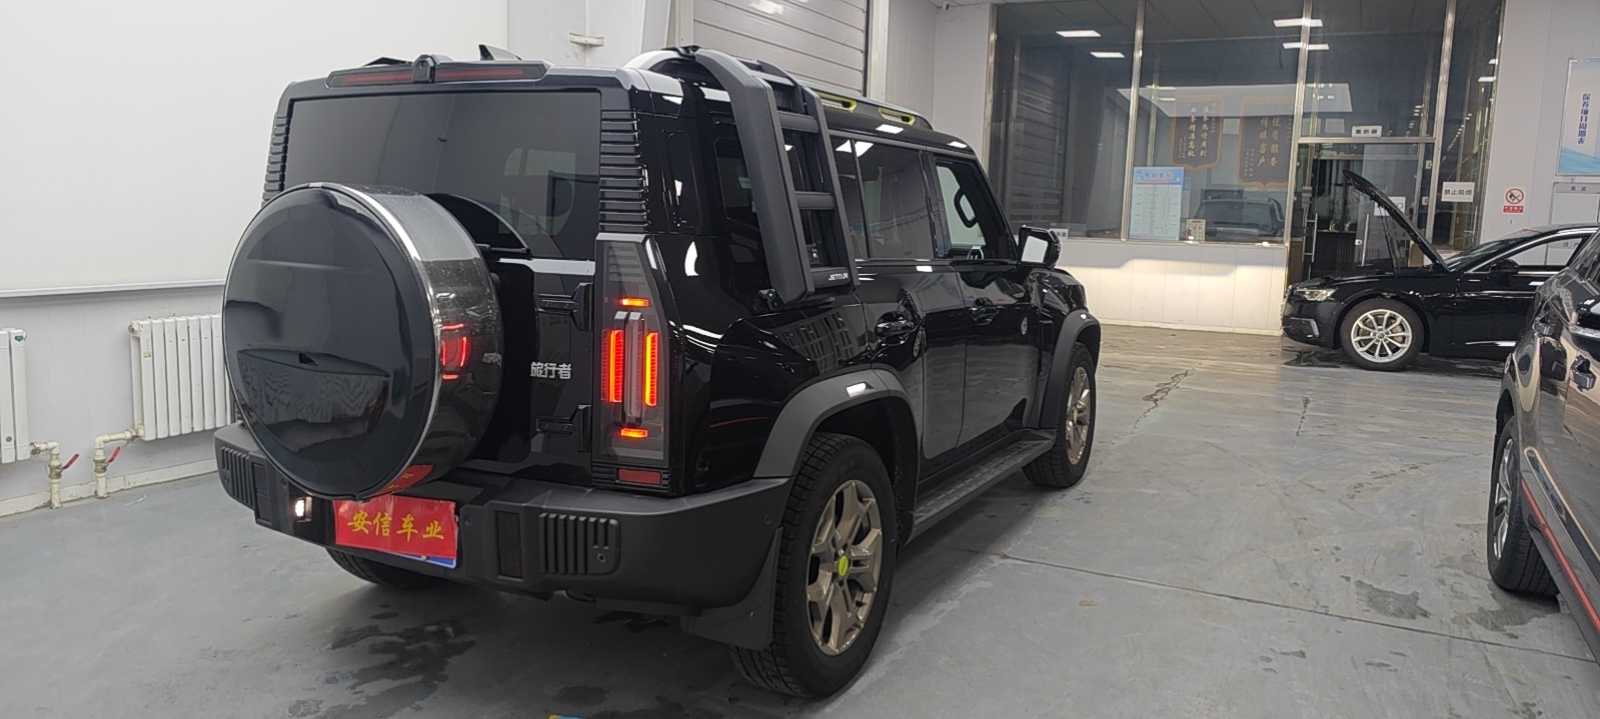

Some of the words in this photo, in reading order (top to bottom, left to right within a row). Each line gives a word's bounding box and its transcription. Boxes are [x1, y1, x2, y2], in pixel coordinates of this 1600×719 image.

[529, 361, 573, 380] 旅行者
[347, 510, 445, 543] 安信车业
